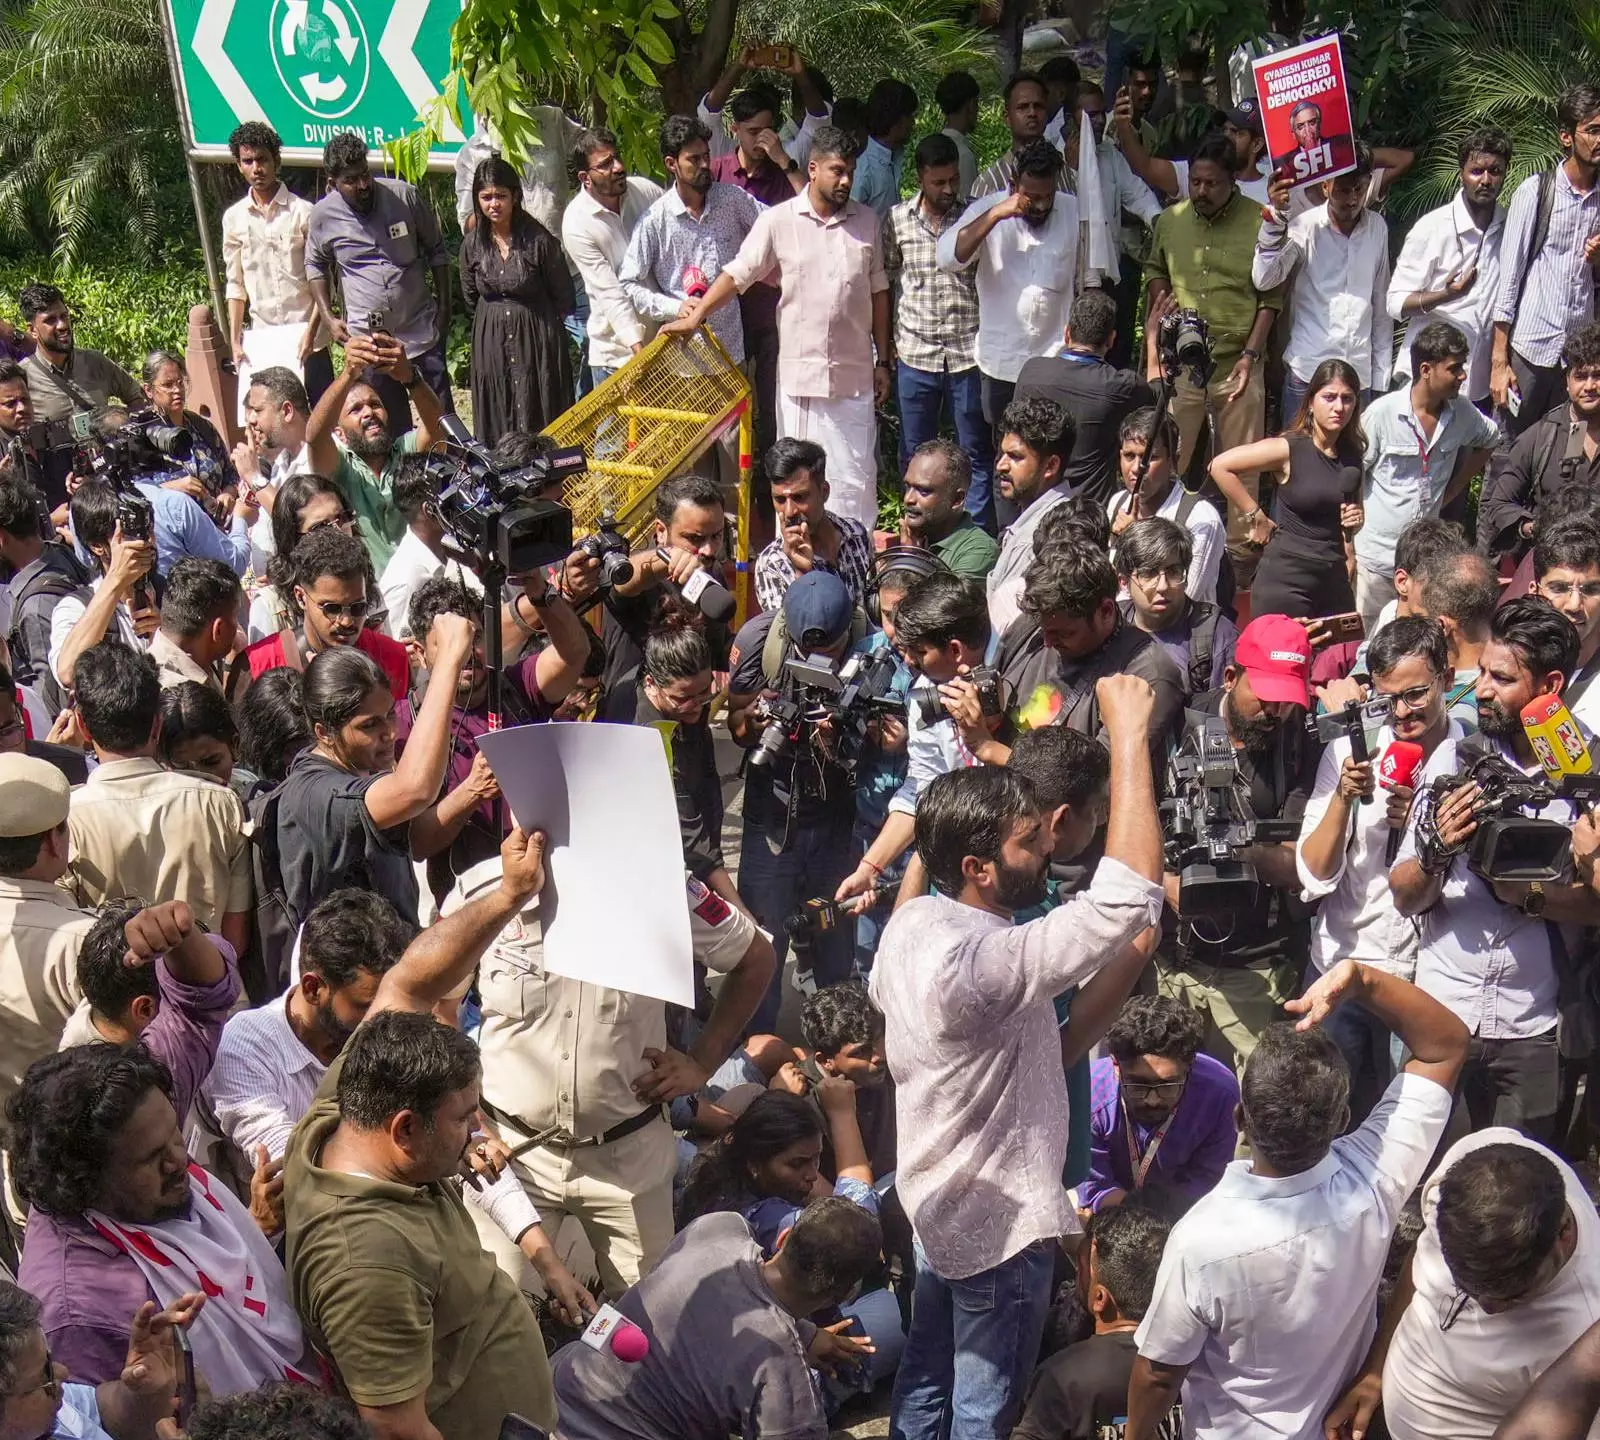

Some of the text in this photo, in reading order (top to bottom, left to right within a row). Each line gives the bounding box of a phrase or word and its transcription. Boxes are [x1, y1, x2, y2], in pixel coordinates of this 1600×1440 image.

[1263, 52, 1331, 82] GYANESH KUMAR
[1268, 63, 1331, 94] MURDERED
[1267, 75, 1337, 109] DEMOCRACY!
[1293, 143, 1333, 180] SFI
